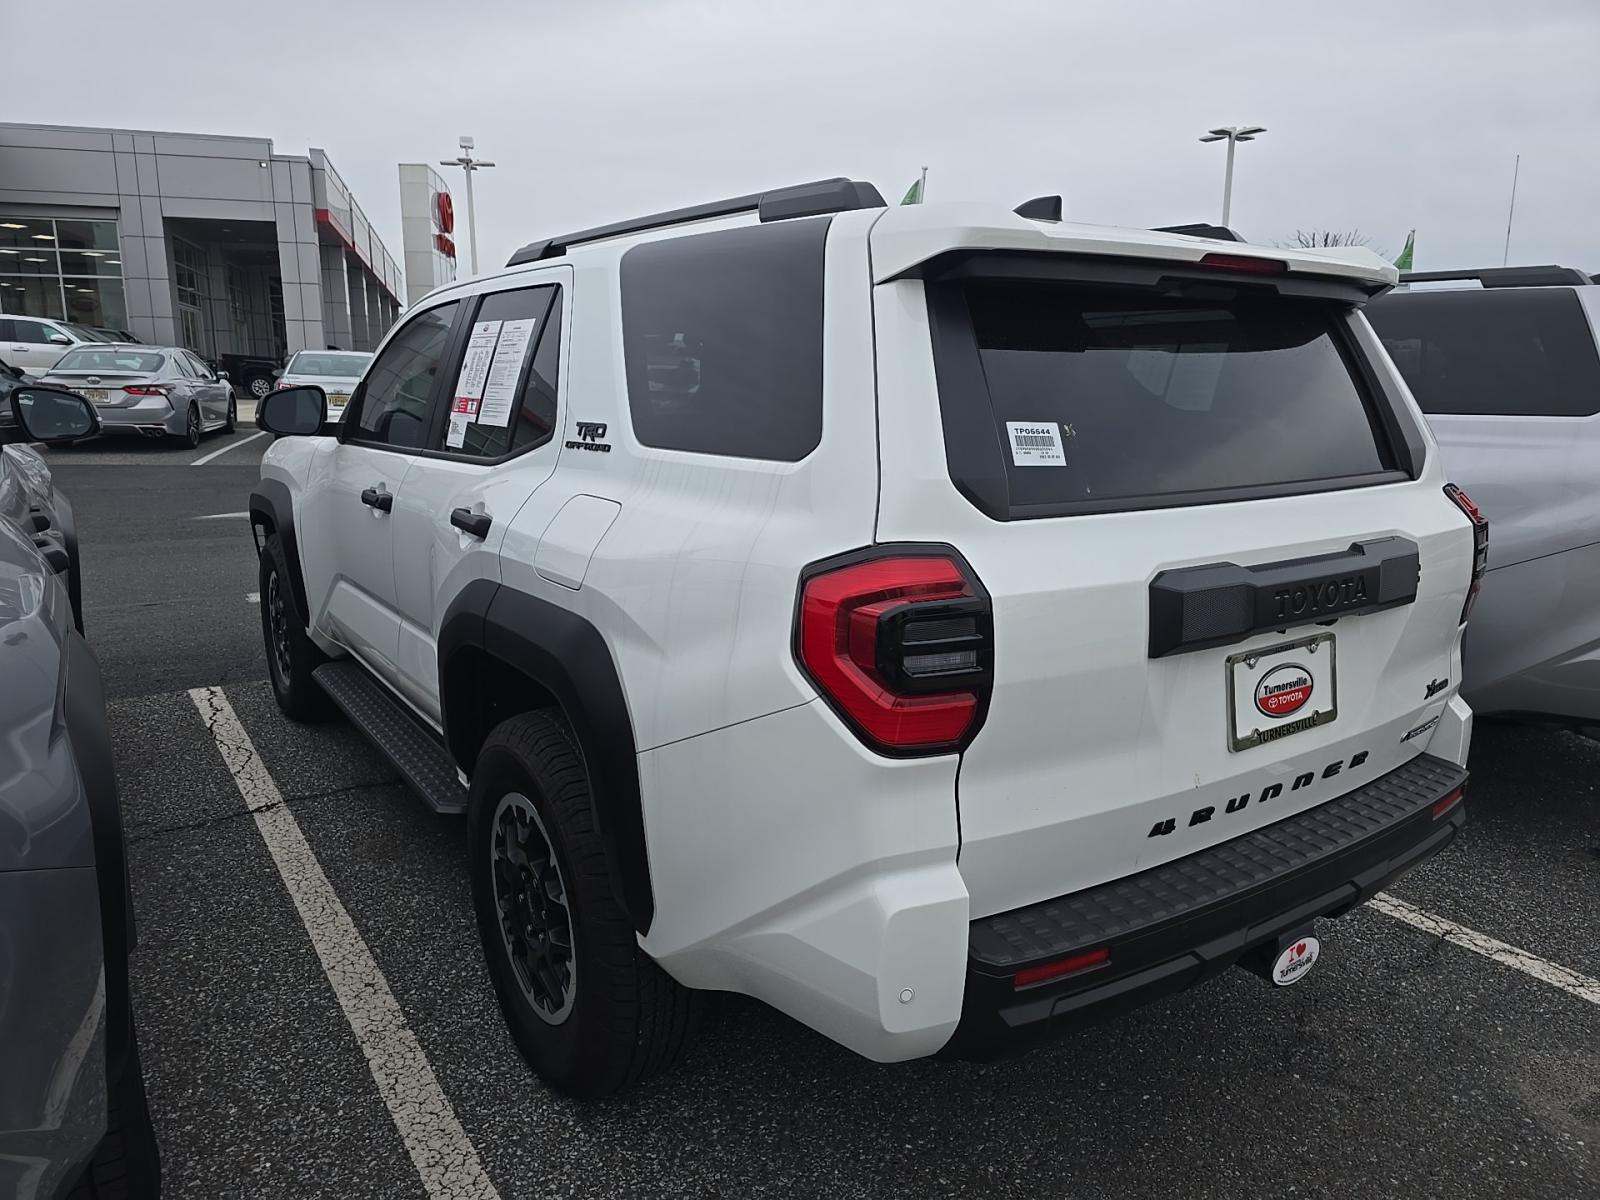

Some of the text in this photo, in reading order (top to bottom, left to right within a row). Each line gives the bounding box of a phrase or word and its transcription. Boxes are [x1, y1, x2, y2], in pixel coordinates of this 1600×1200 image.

[576, 421, 607, 442] TRD
[1275, 576, 1367, 618] TOYOTA
[1263, 677, 1308, 695] Turnersville
[1279, 691, 1303, 705] TOYOTA
